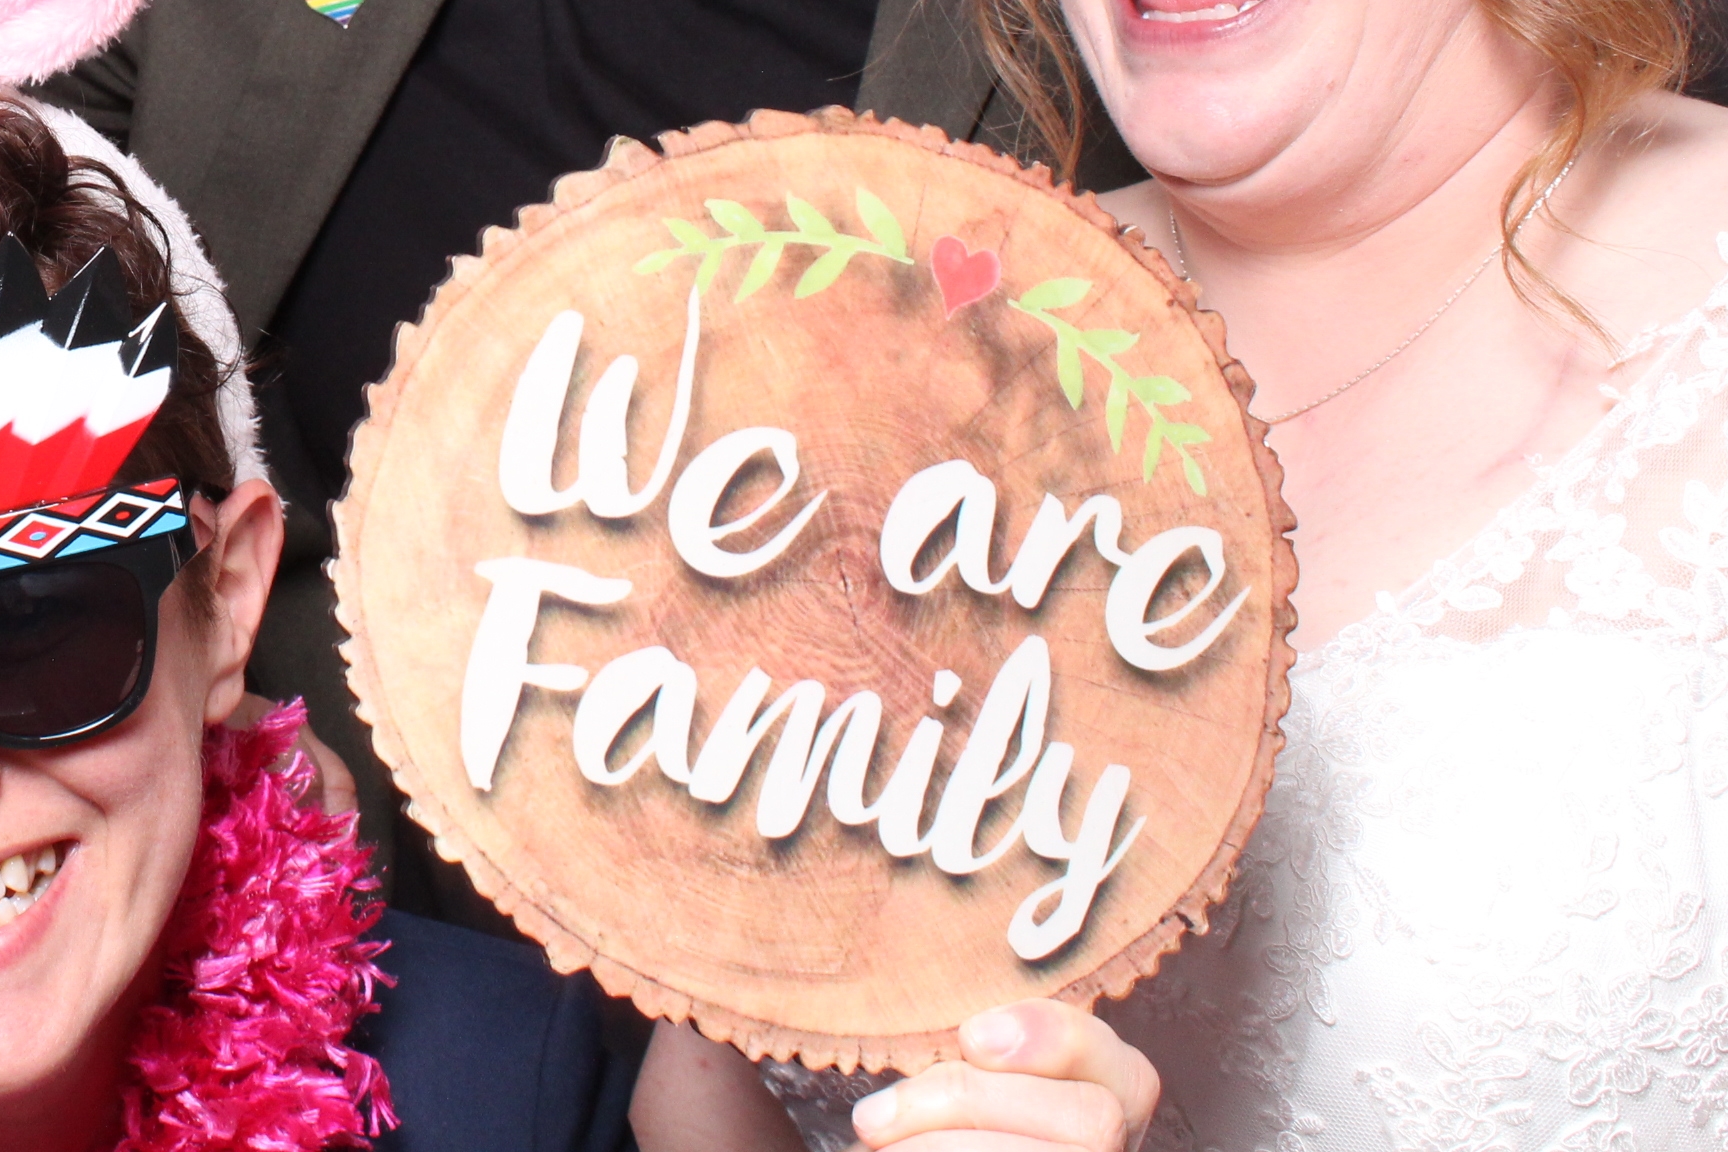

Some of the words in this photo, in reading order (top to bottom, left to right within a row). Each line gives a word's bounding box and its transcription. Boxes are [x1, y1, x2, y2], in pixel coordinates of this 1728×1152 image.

[498, 285, 827, 578] We
[879, 458, 1253, 672] are
[460, 556, 1148, 962] Family
